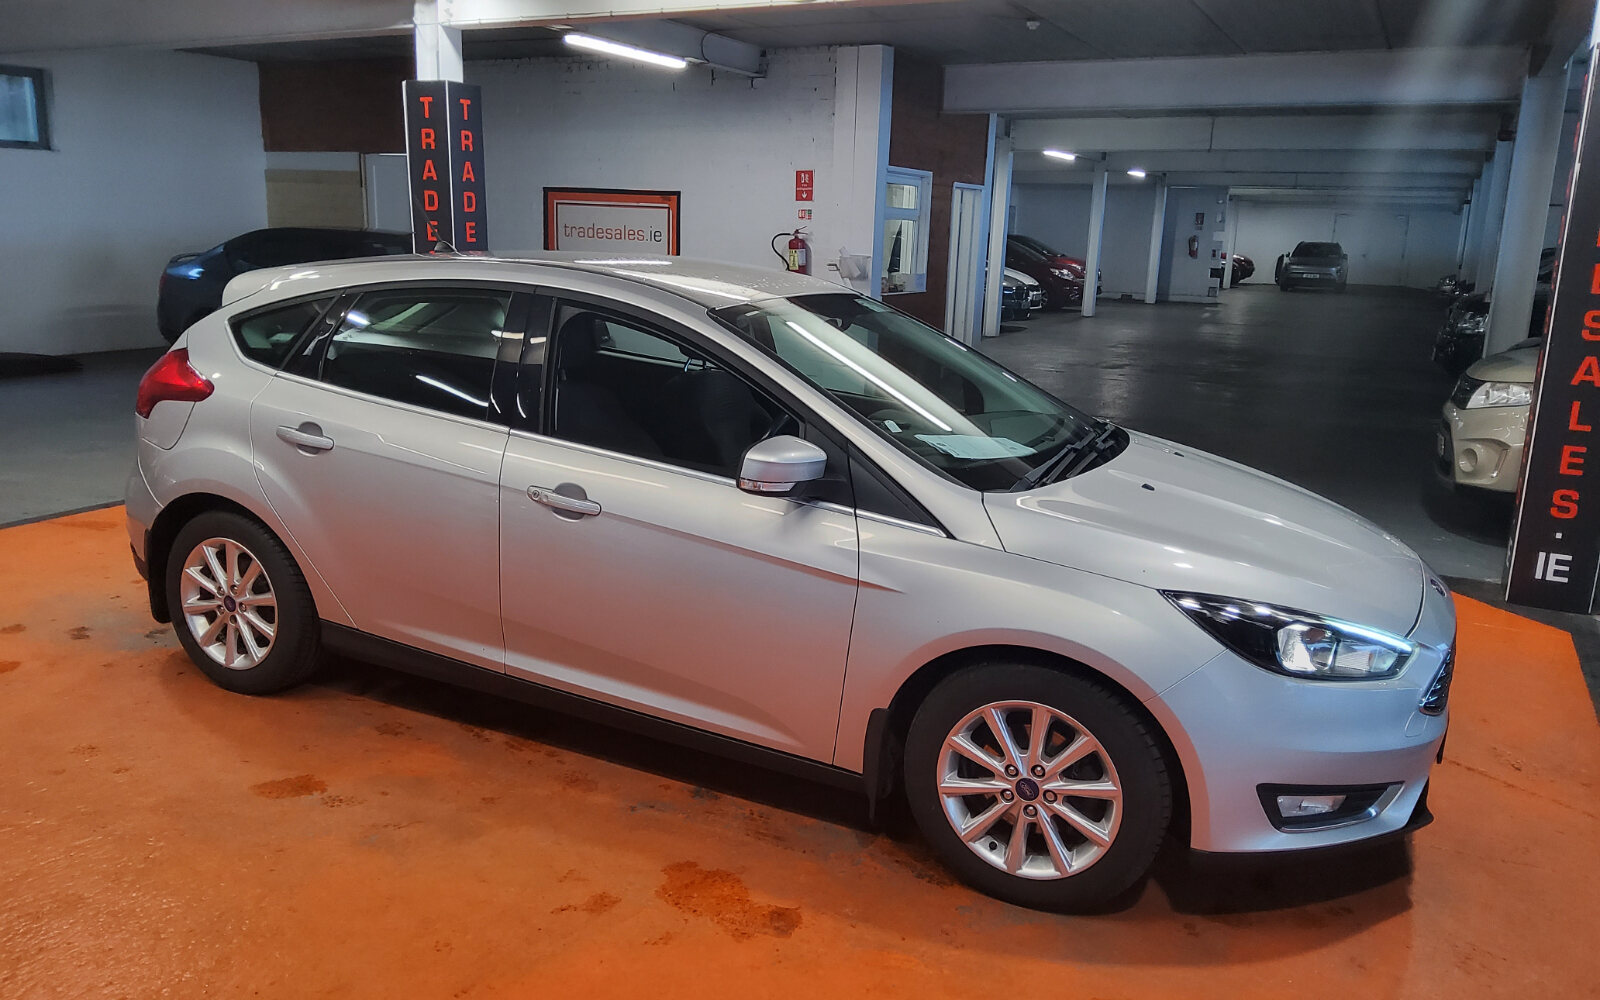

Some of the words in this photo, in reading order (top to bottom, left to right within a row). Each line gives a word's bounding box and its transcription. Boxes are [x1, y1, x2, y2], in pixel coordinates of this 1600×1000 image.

[419, 96, 439, 254] TRADE
[459, 98, 477, 243] TRADE
[563, 223, 663, 243] tradesales.ie
